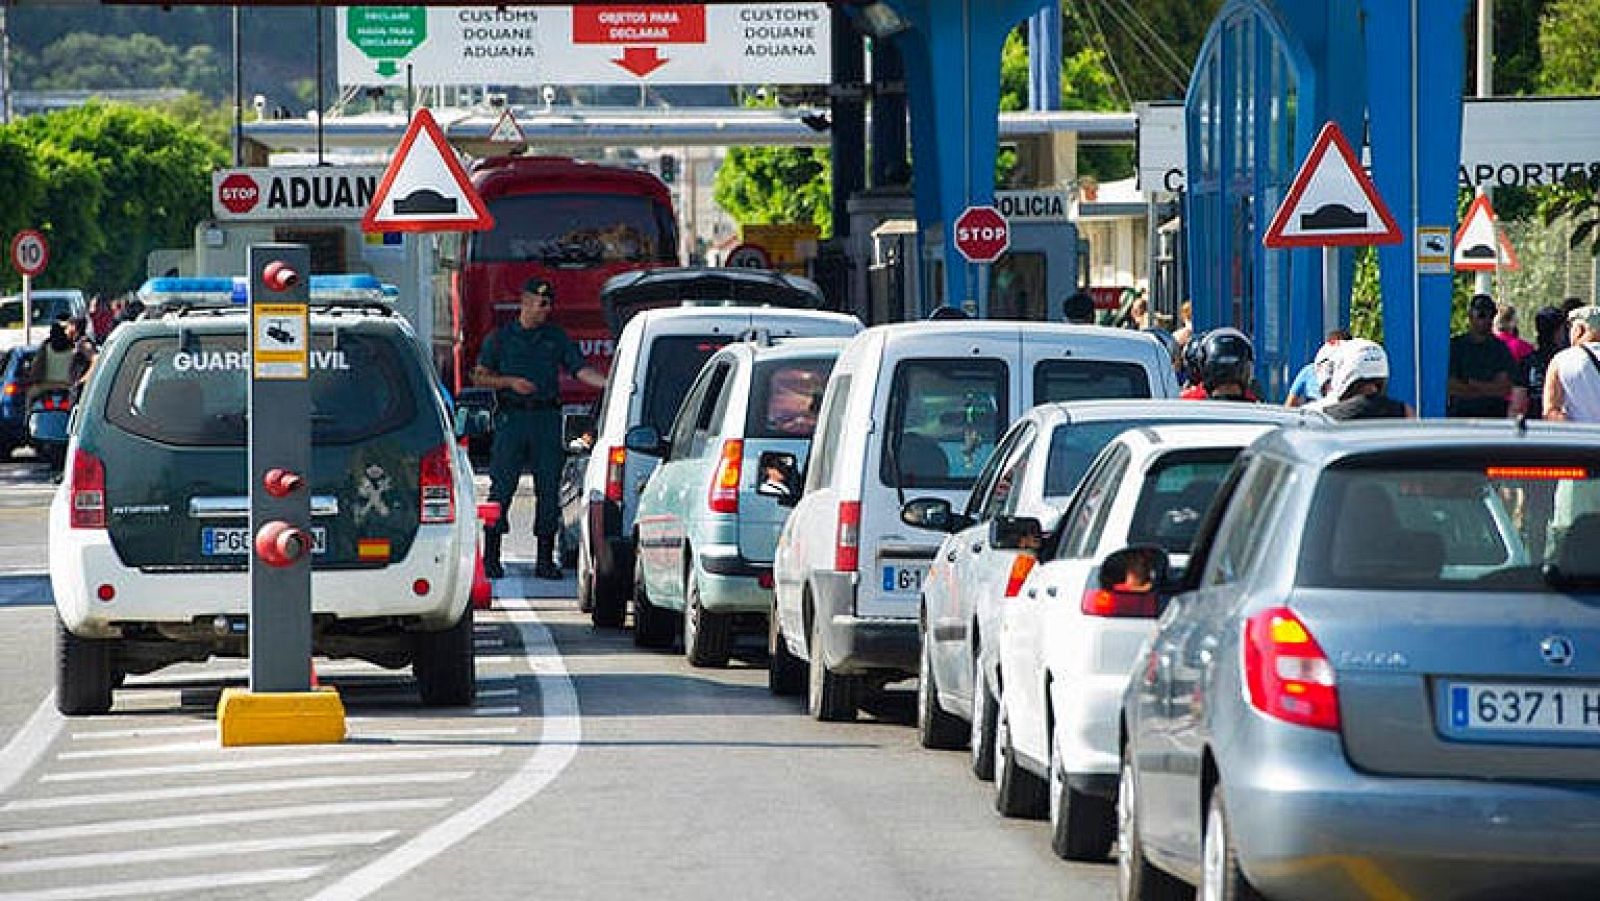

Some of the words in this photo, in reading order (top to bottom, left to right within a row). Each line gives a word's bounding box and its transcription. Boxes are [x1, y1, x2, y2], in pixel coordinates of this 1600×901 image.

[459, 9, 538, 21] CUSTOMS
[741, 9, 819, 21] CUSTOMS
[464, 28, 531, 40] DOUANE
[745, 26, 815, 38] DOUANE
[464, 46, 534, 57] ADUANA
[745, 44, 816, 57] ADUANA
[222, 187, 257, 200] STOP
[958, 227, 1005, 241] STOP
[21, 244, 41, 263] 10
[1479, 690, 1563, 724] 6371
[1583, 693, 1600, 724] H
